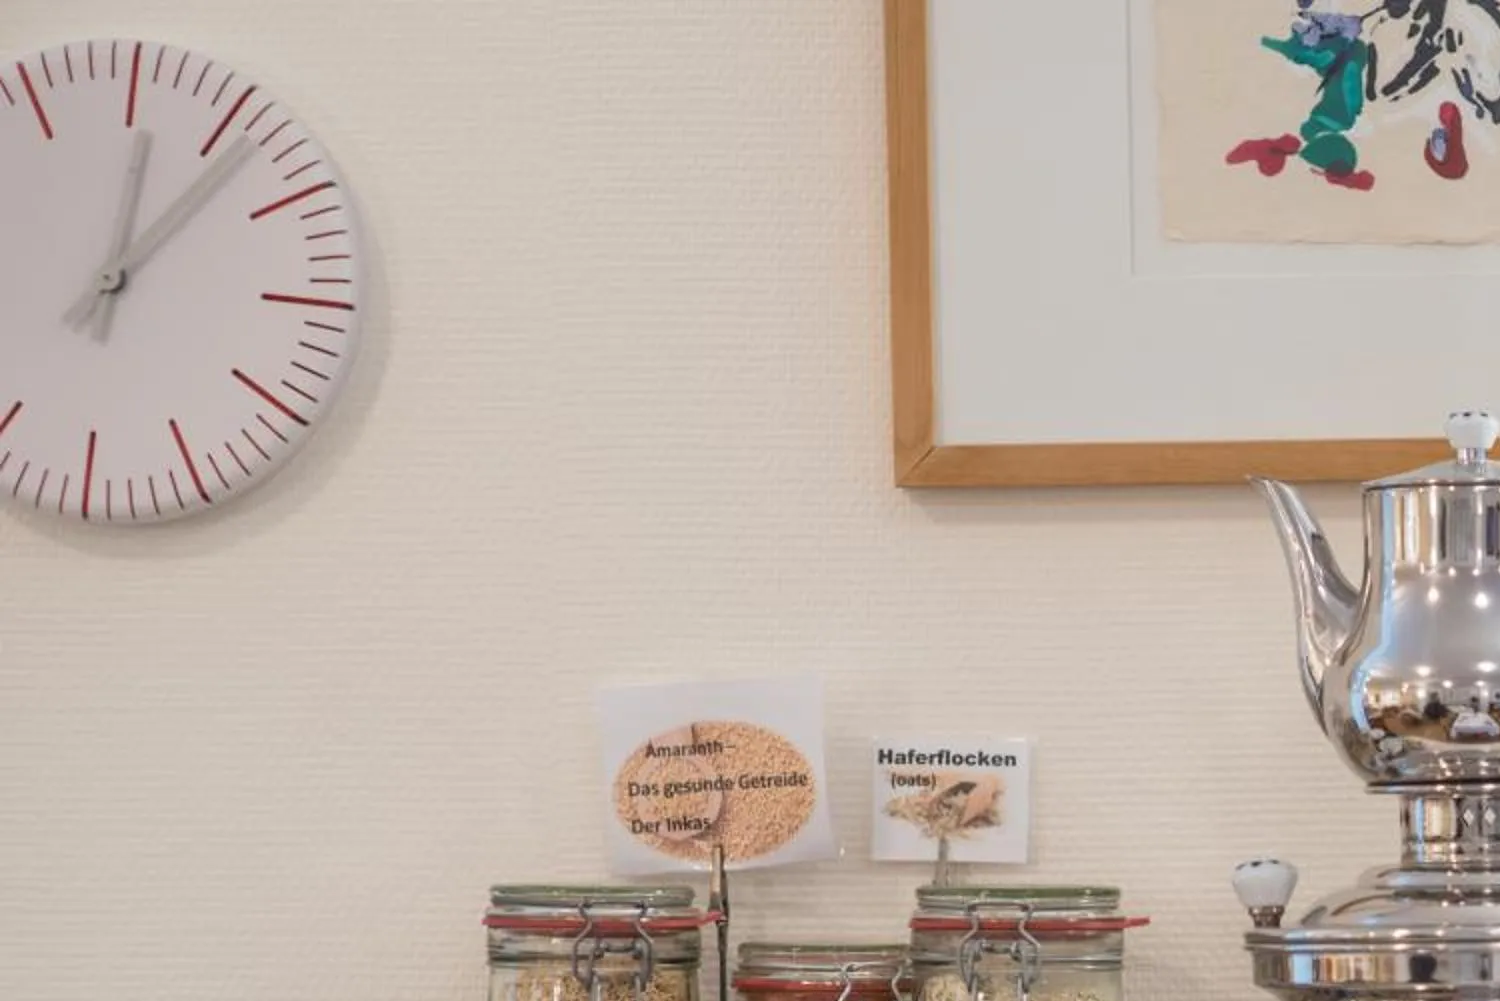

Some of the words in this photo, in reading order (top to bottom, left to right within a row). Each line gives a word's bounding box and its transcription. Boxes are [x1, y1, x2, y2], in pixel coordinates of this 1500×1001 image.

[877, 748, 1018, 768] Haferflocken
[628, 780, 660, 798] Das
[663, 776, 735, 797] gesunde
[737, 772, 808, 791] Getreide
[891, 773, 937, 789] (oats)
[631, 817, 663, 835] Der
[666, 815, 712, 834] Inkas
